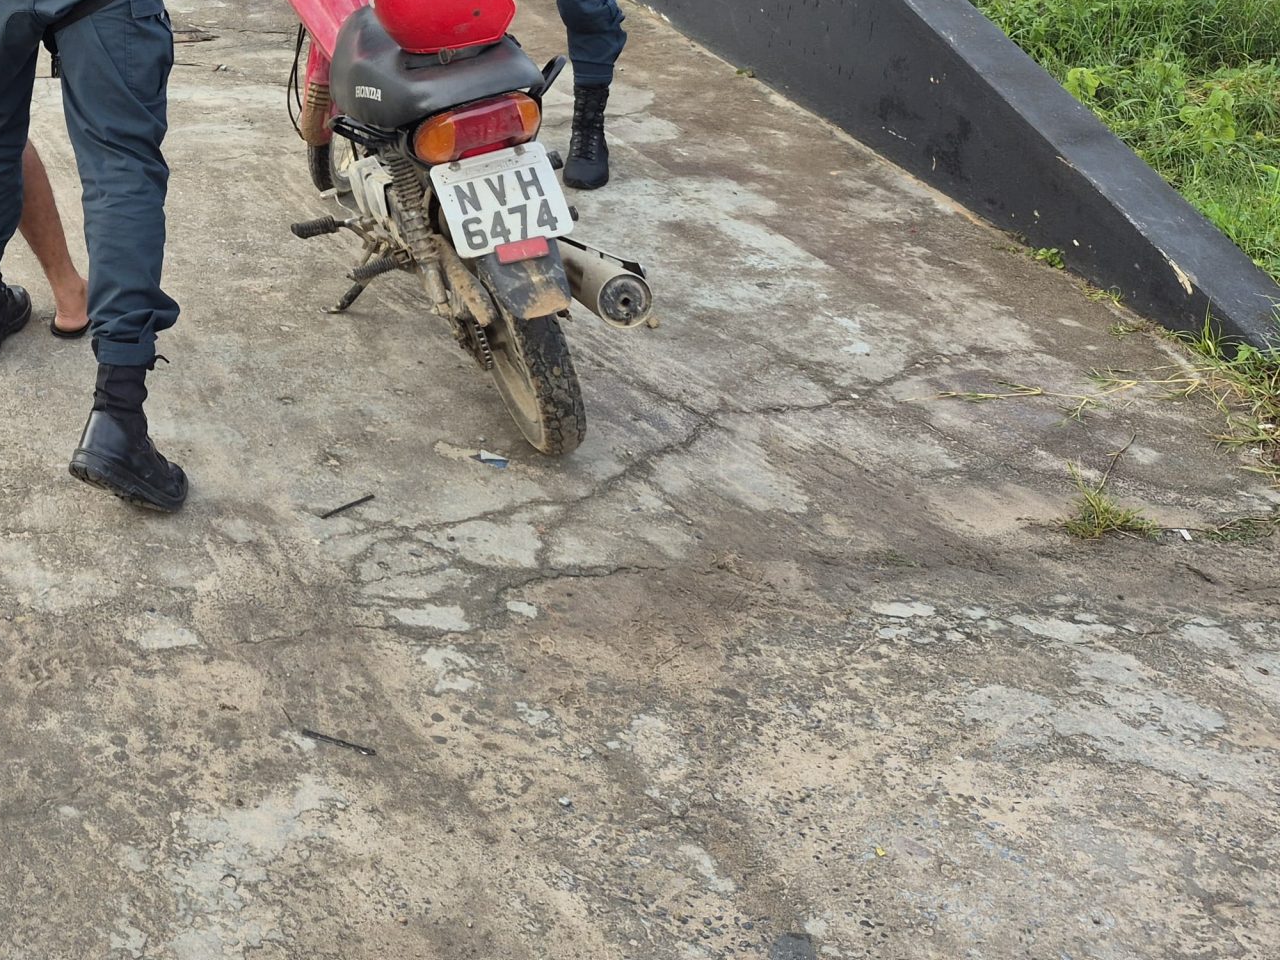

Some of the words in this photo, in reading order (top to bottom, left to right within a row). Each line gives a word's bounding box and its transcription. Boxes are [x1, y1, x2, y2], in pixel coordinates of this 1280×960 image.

[355, 85, 382, 102] HONDA
[454, 166, 545, 216] NVH
[461, 198, 559, 250] 6474
